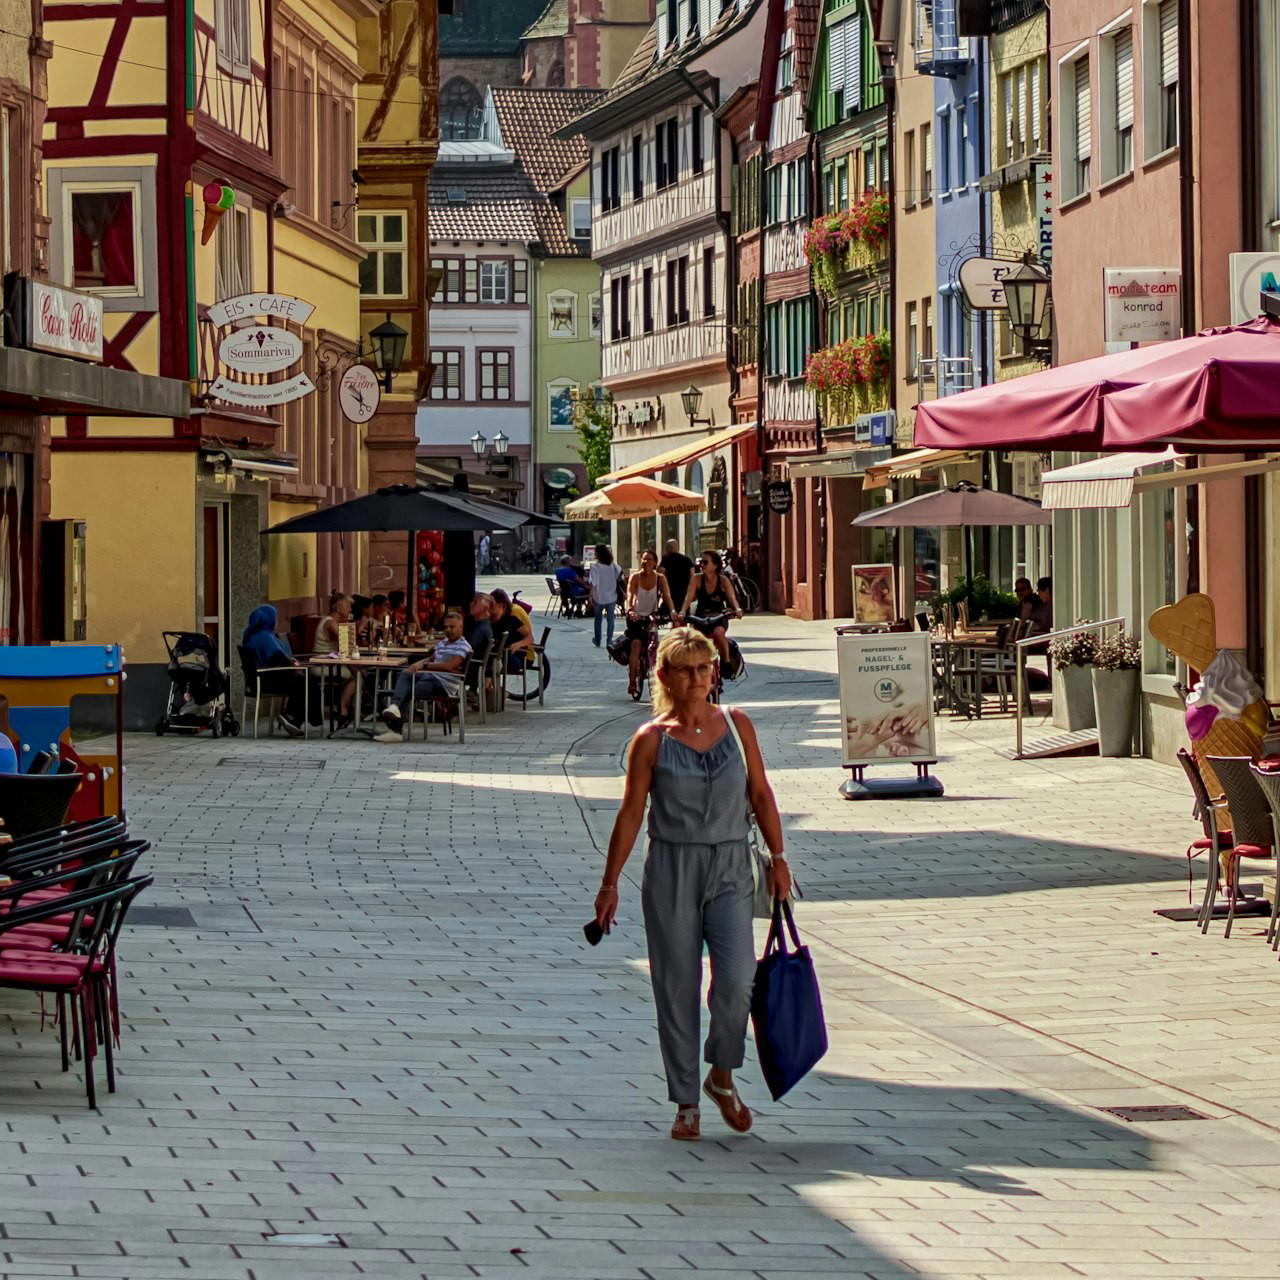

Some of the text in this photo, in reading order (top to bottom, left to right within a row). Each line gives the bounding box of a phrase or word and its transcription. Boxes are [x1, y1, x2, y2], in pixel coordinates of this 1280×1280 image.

[1108, 283, 1178, 296] modeteam
[224, 301, 245, 319] EIS
[1123, 300, 1163, 312] konrad
[230, 346, 292, 359] Sommariva
[858, 663, 912, 673] FUSSPFLEGE
